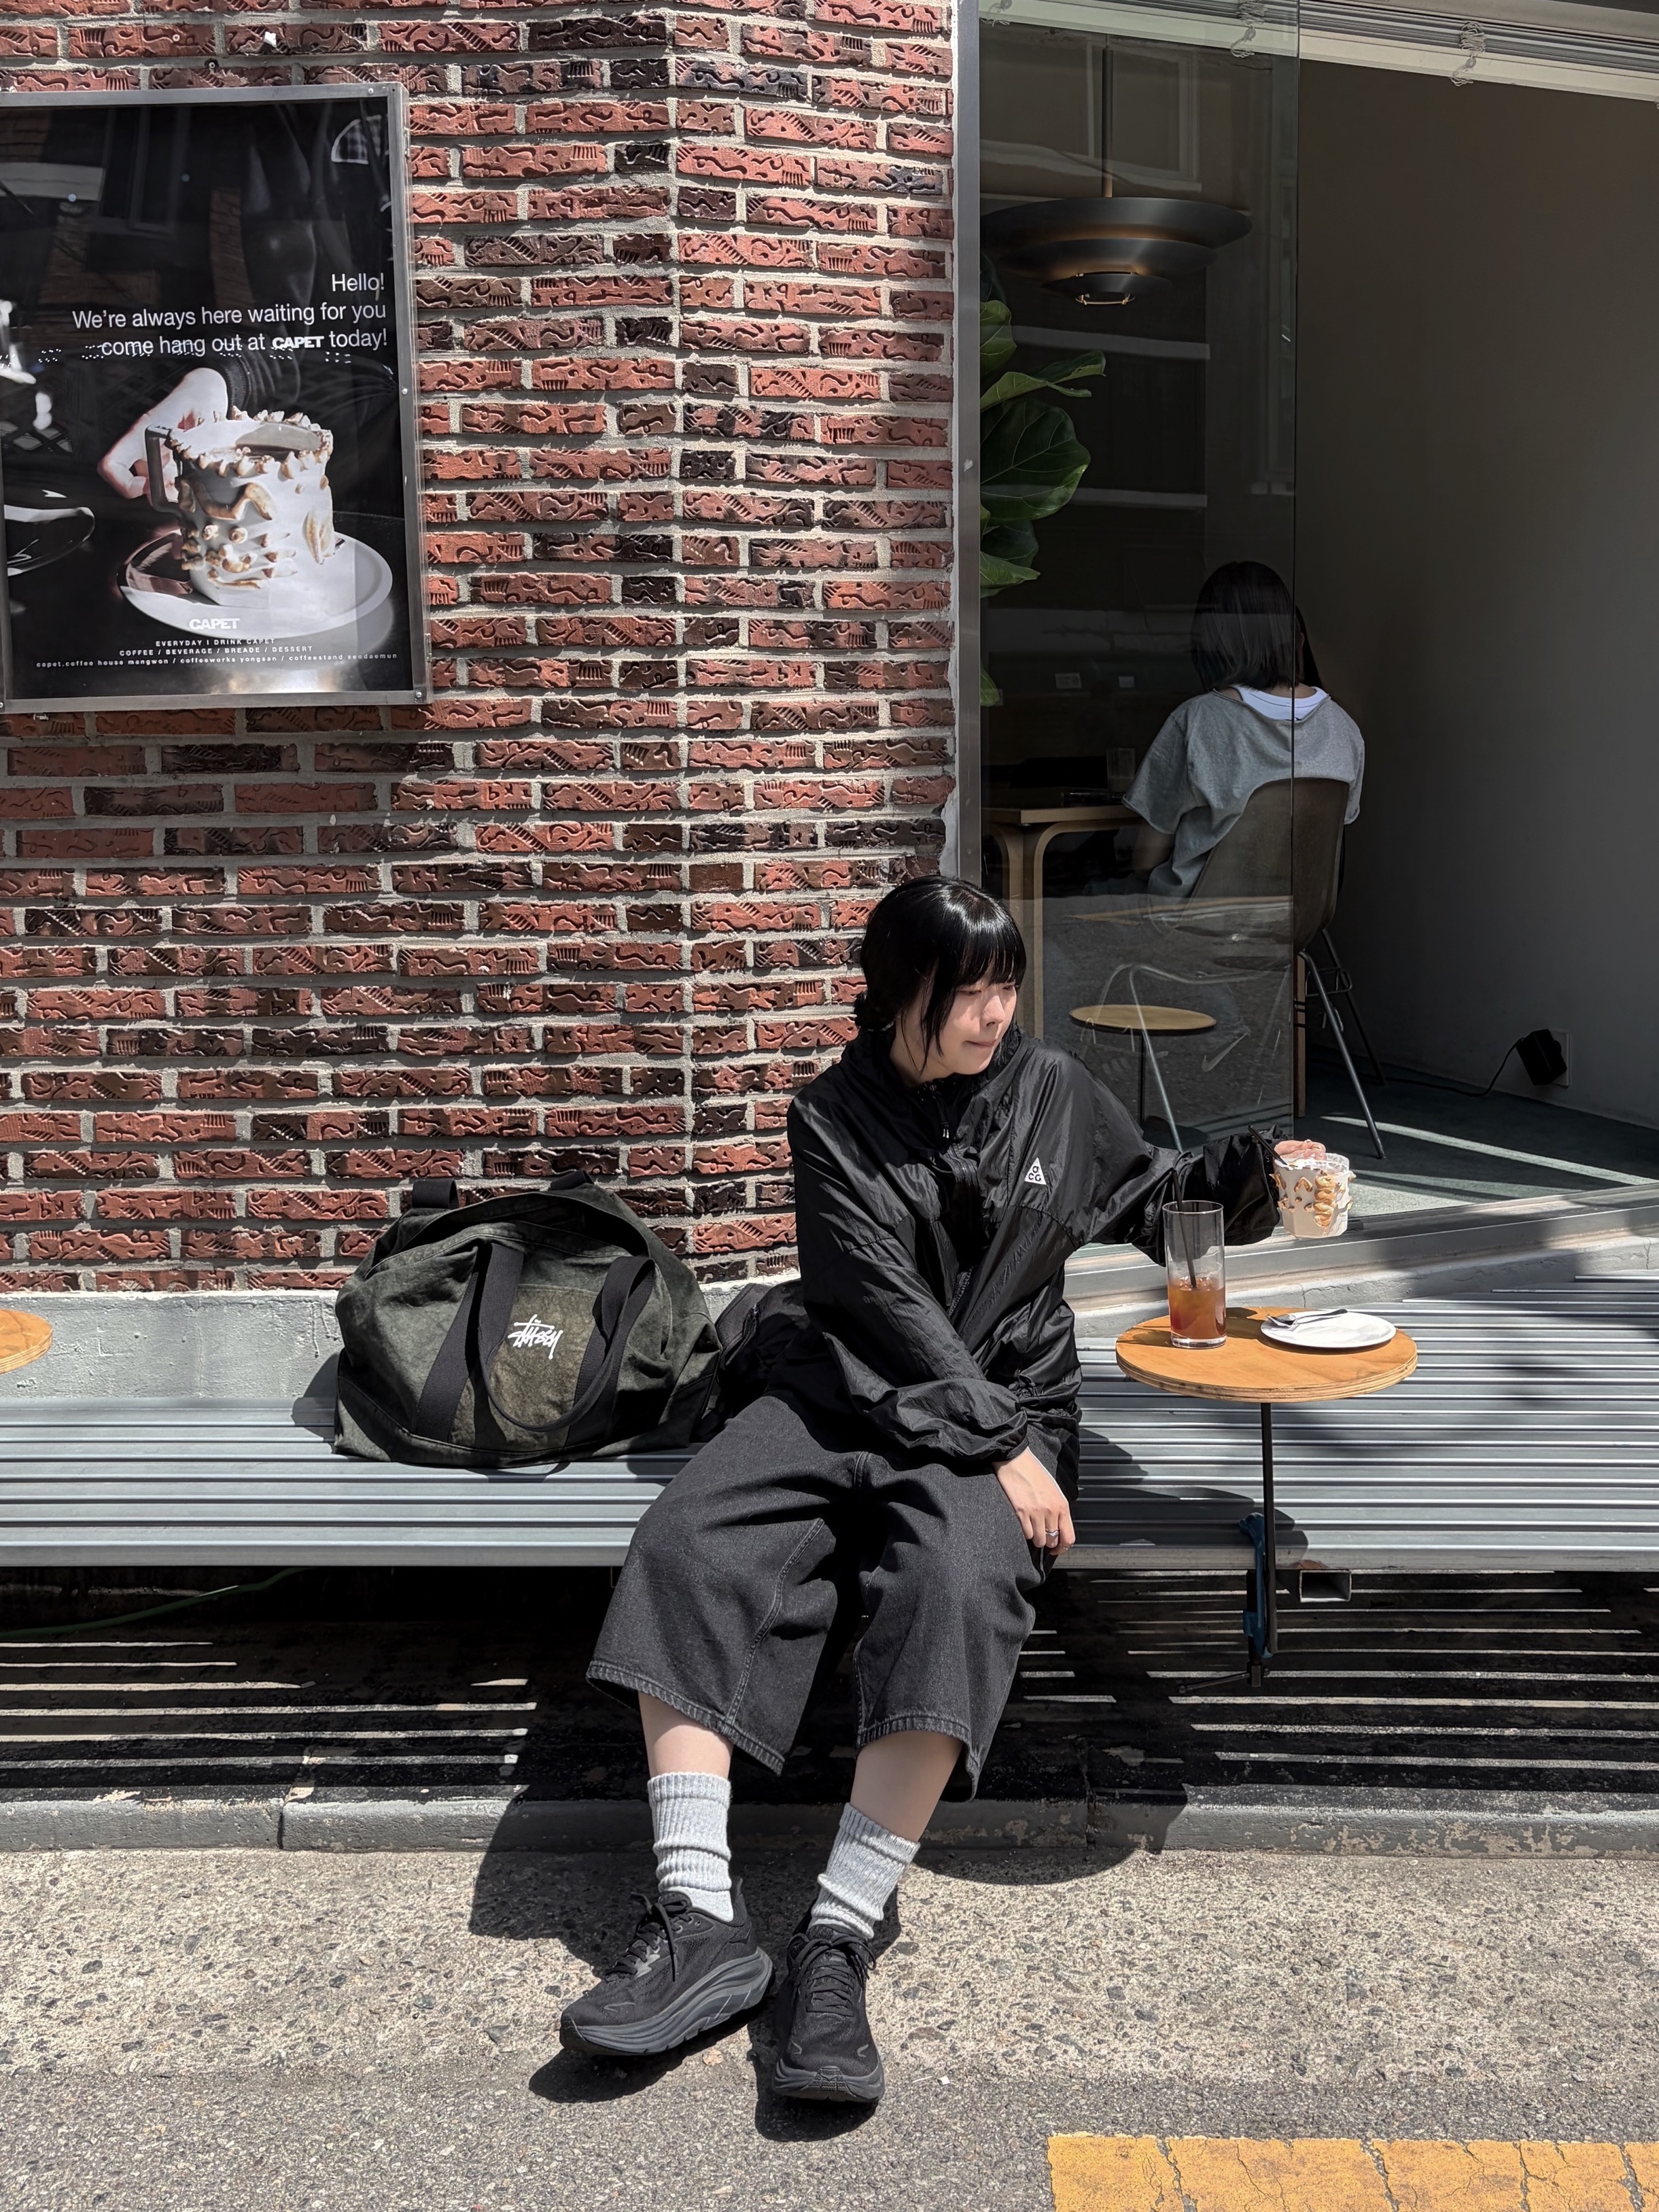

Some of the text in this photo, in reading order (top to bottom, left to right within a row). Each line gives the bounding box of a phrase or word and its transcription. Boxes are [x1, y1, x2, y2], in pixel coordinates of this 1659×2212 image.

[332, 273, 385, 292] Hello!
[132, 309, 196, 330] always
[202, 307, 243, 324] here
[247, 303, 315, 326] waiting
[320, 302, 347, 320] for
[351, 305, 386, 324] you
[102, 328, 387, 357] come hang out at CAPET today!
[189, 618, 240, 630] CAPET
